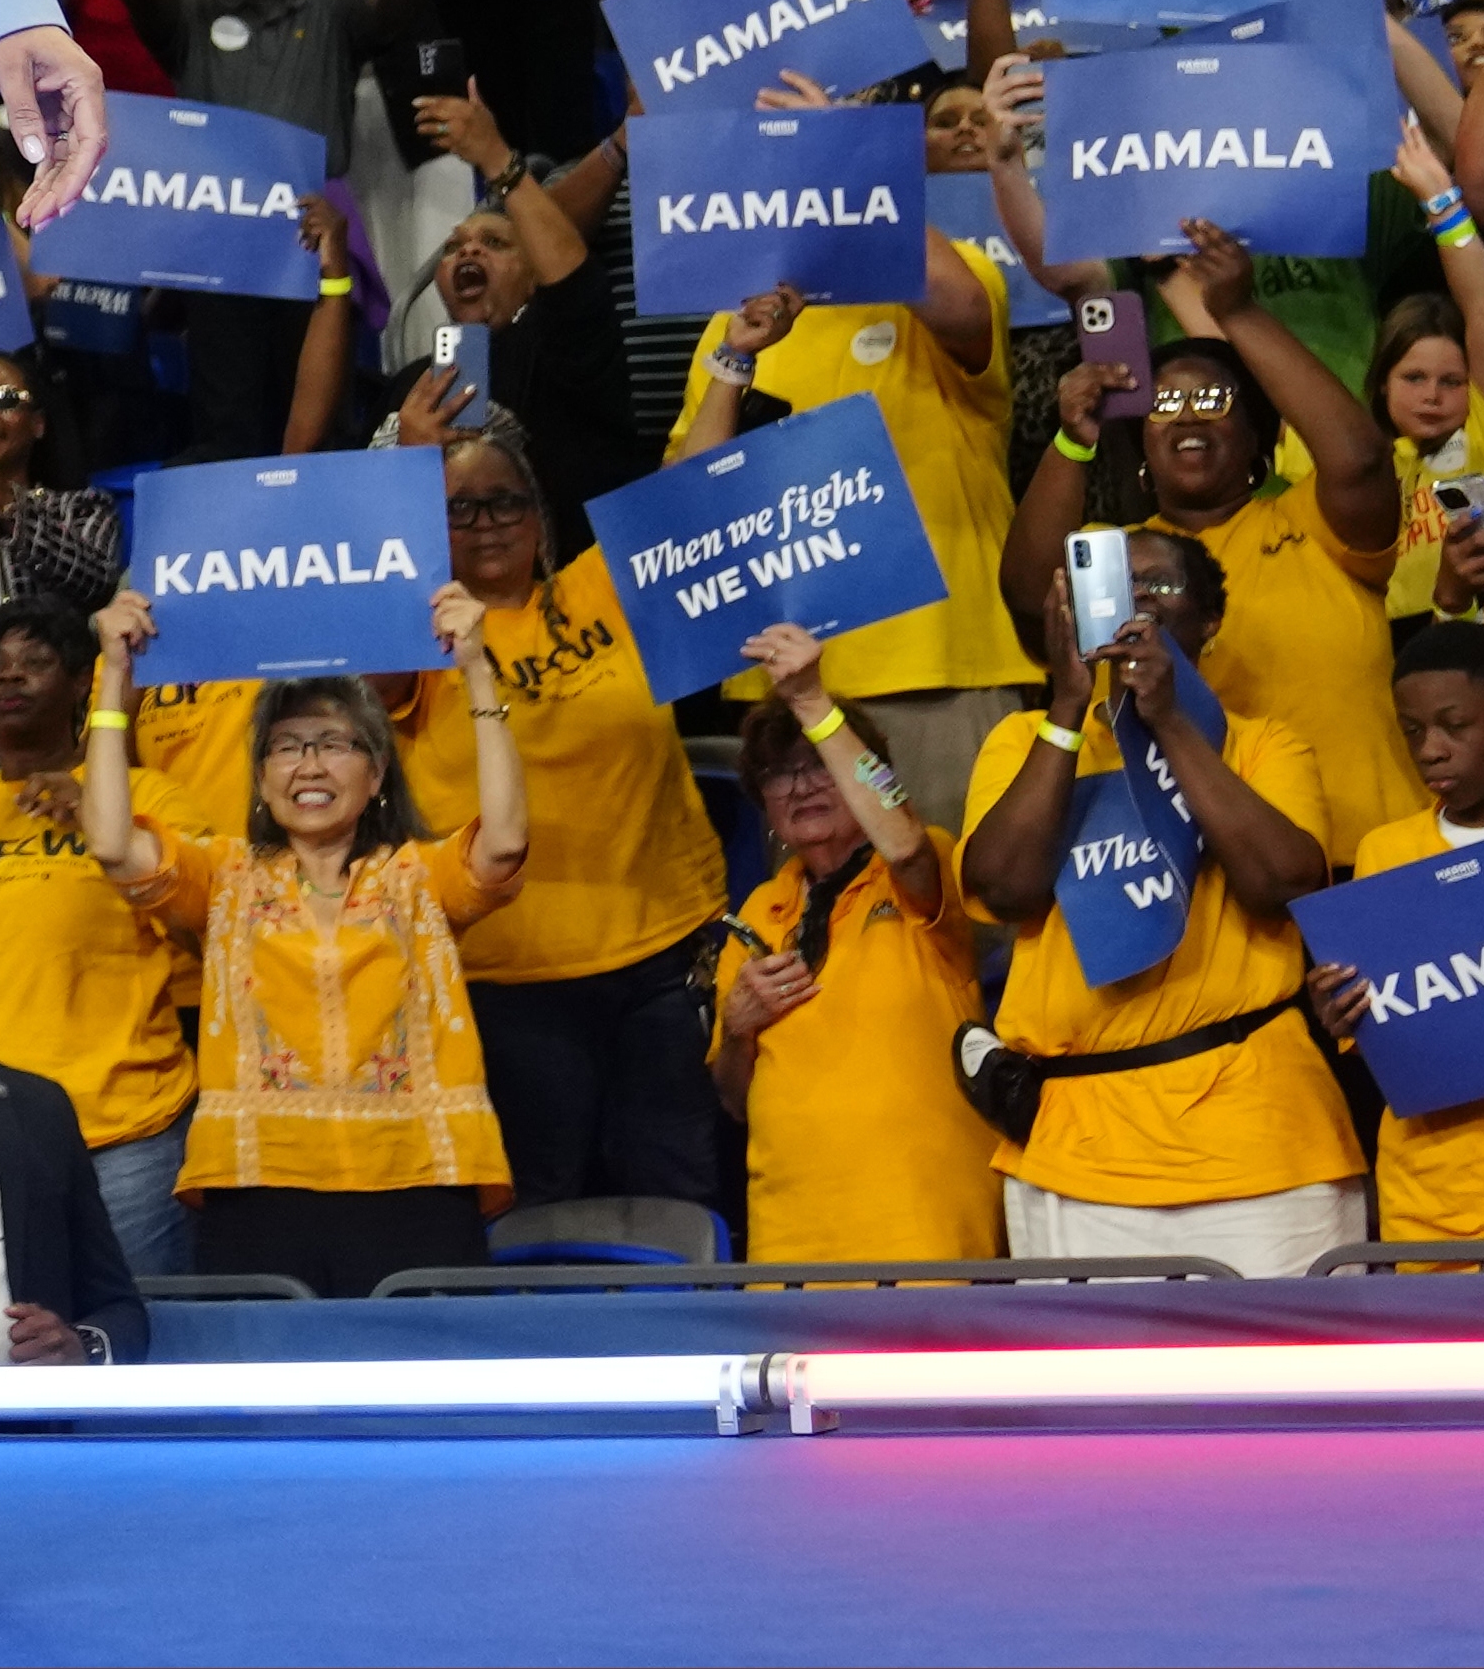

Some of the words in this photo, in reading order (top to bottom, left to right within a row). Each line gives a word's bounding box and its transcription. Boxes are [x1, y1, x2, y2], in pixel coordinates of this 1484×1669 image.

[1071, 128, 1334, 181] KAMALA
[659, 186, 900, 233] KAMALA
[631, 533, 727, 590] When
[727, 507, 774, 548] we
[777, 467, 885, 542] fight,
[154, 540, 419, 598] KAMALA
[676, 565, 747, 619] WE
[747, 529, 863, 587] WIN.
[1071, 833, 1160, 879] Whe
[1123, 871, 1175, 910] W
